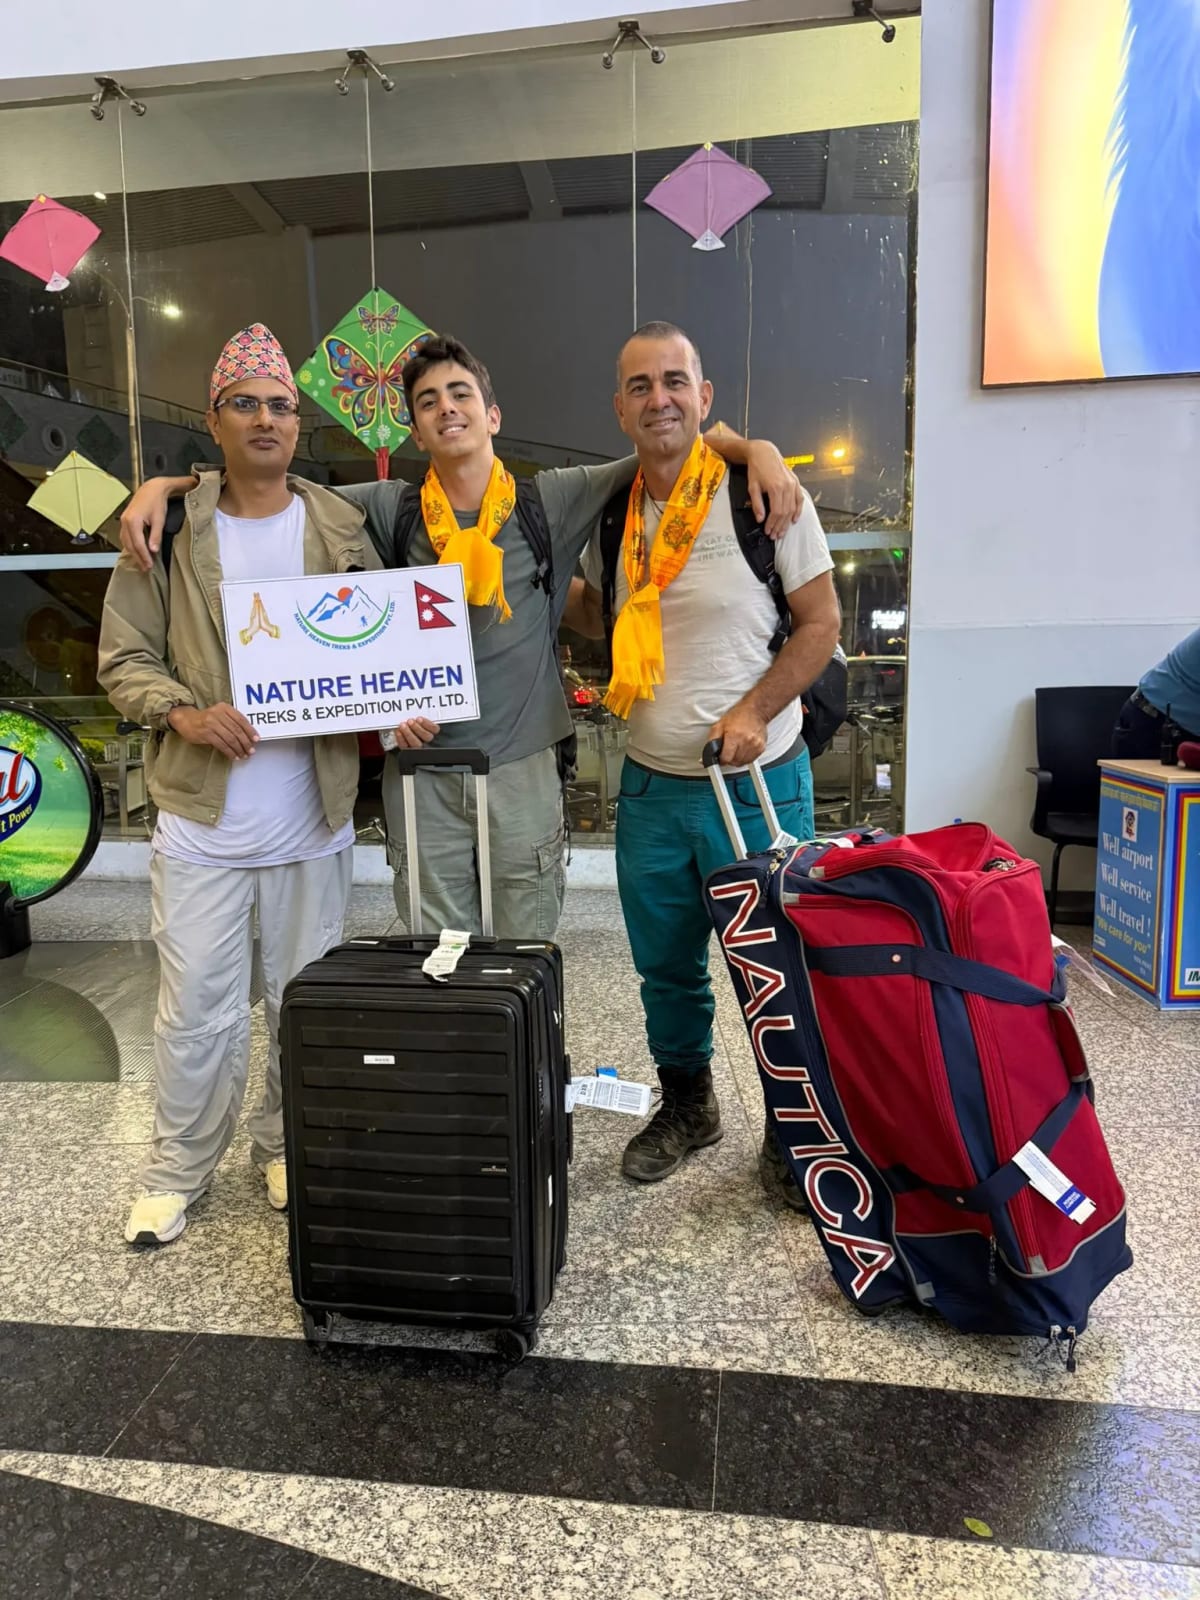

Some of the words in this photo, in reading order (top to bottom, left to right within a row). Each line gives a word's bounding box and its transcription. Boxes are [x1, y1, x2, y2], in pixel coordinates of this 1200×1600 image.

[293, 612, 309, 635] NATURE
[308, 631, 331, 648] HEAVEN
[357, 625, 388, 648] EXPEDITION
[245, 675, 353, 705] NATURE
[360, 664, 464, 695] HEAVEN
[247, 709, 297, 726] TREKS
[302, 708, 313, 721] &
[316, 700, 402, 719] EXPEDITION
[406, 696, 436, 711] PVT.
[439, 692, 469, 708] LTD.
[8, 803, 33, 829] Power
[1102, 832, 1120, 857] Well
[1121, 842, 1154, 871] airport
[1100, 862, 1119, 888] Well
[1120, 877, 1152, 904] service
[1099, 892, 1117, 919] Well
[1118, 906, 1145, 935] travel
[1108, 925, 1123, 940] care
[1123, 930, 1133, 945] for
[708, 878, 896, 1300] NAUTICA
